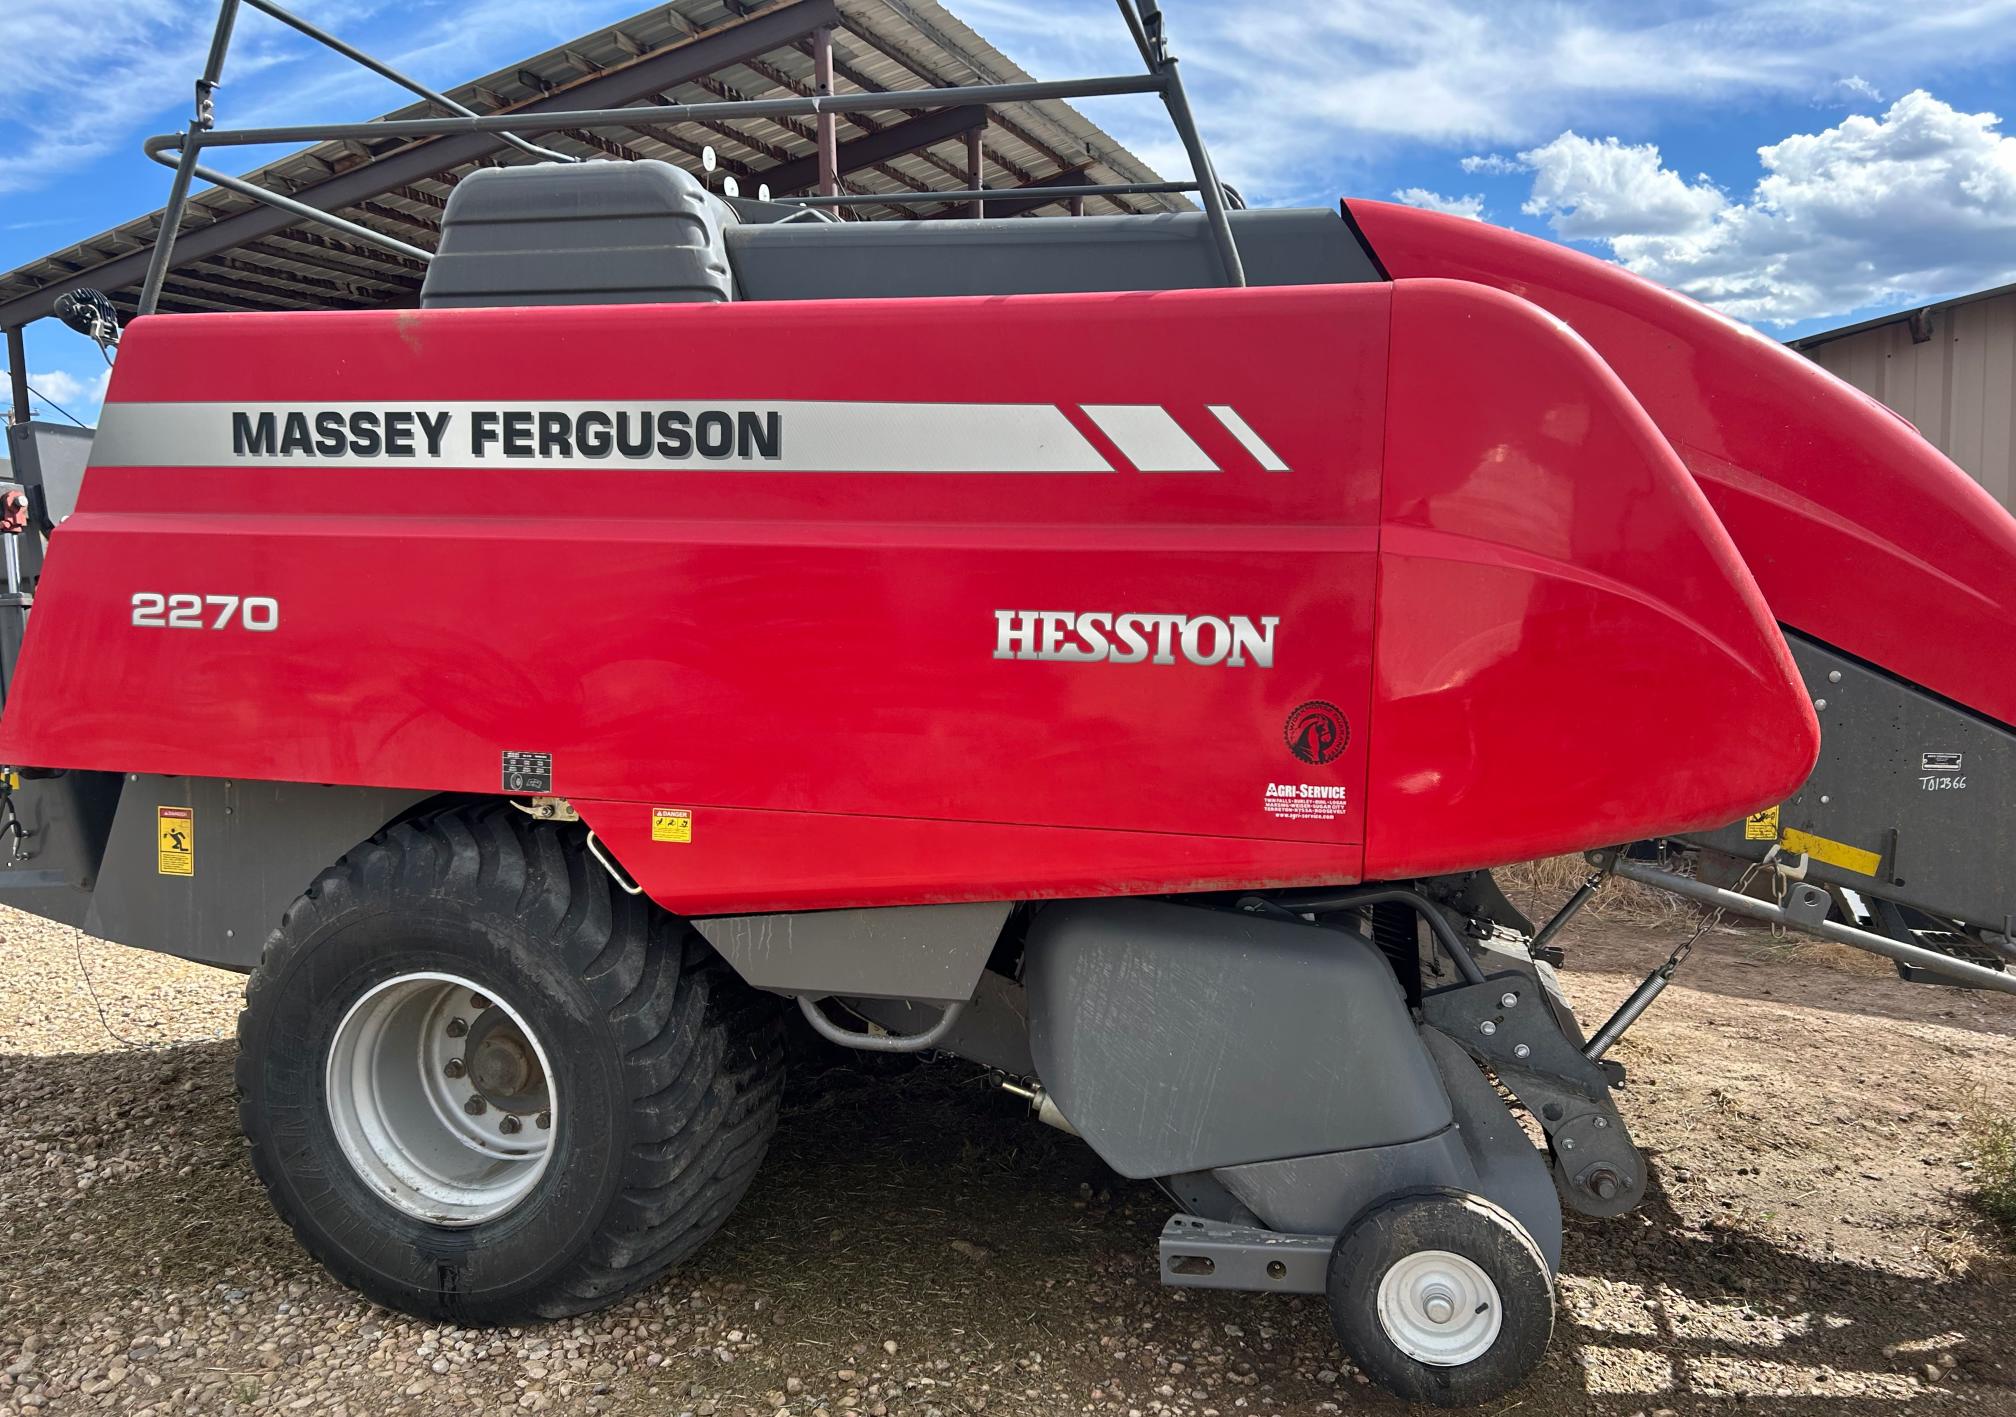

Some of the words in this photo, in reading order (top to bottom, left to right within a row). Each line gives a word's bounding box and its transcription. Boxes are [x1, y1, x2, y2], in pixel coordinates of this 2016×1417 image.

[232, 411, 453, 457] MASSEY
[471, 411, 782, 459] FERGUSON
[132, 592, 279, 631] 2270
[992, 609, 1280, 668] HESSTON
[1265, 782, 1346, 799] AGRI-SERVICE
[1918, 775, 1967, 790] T012366
